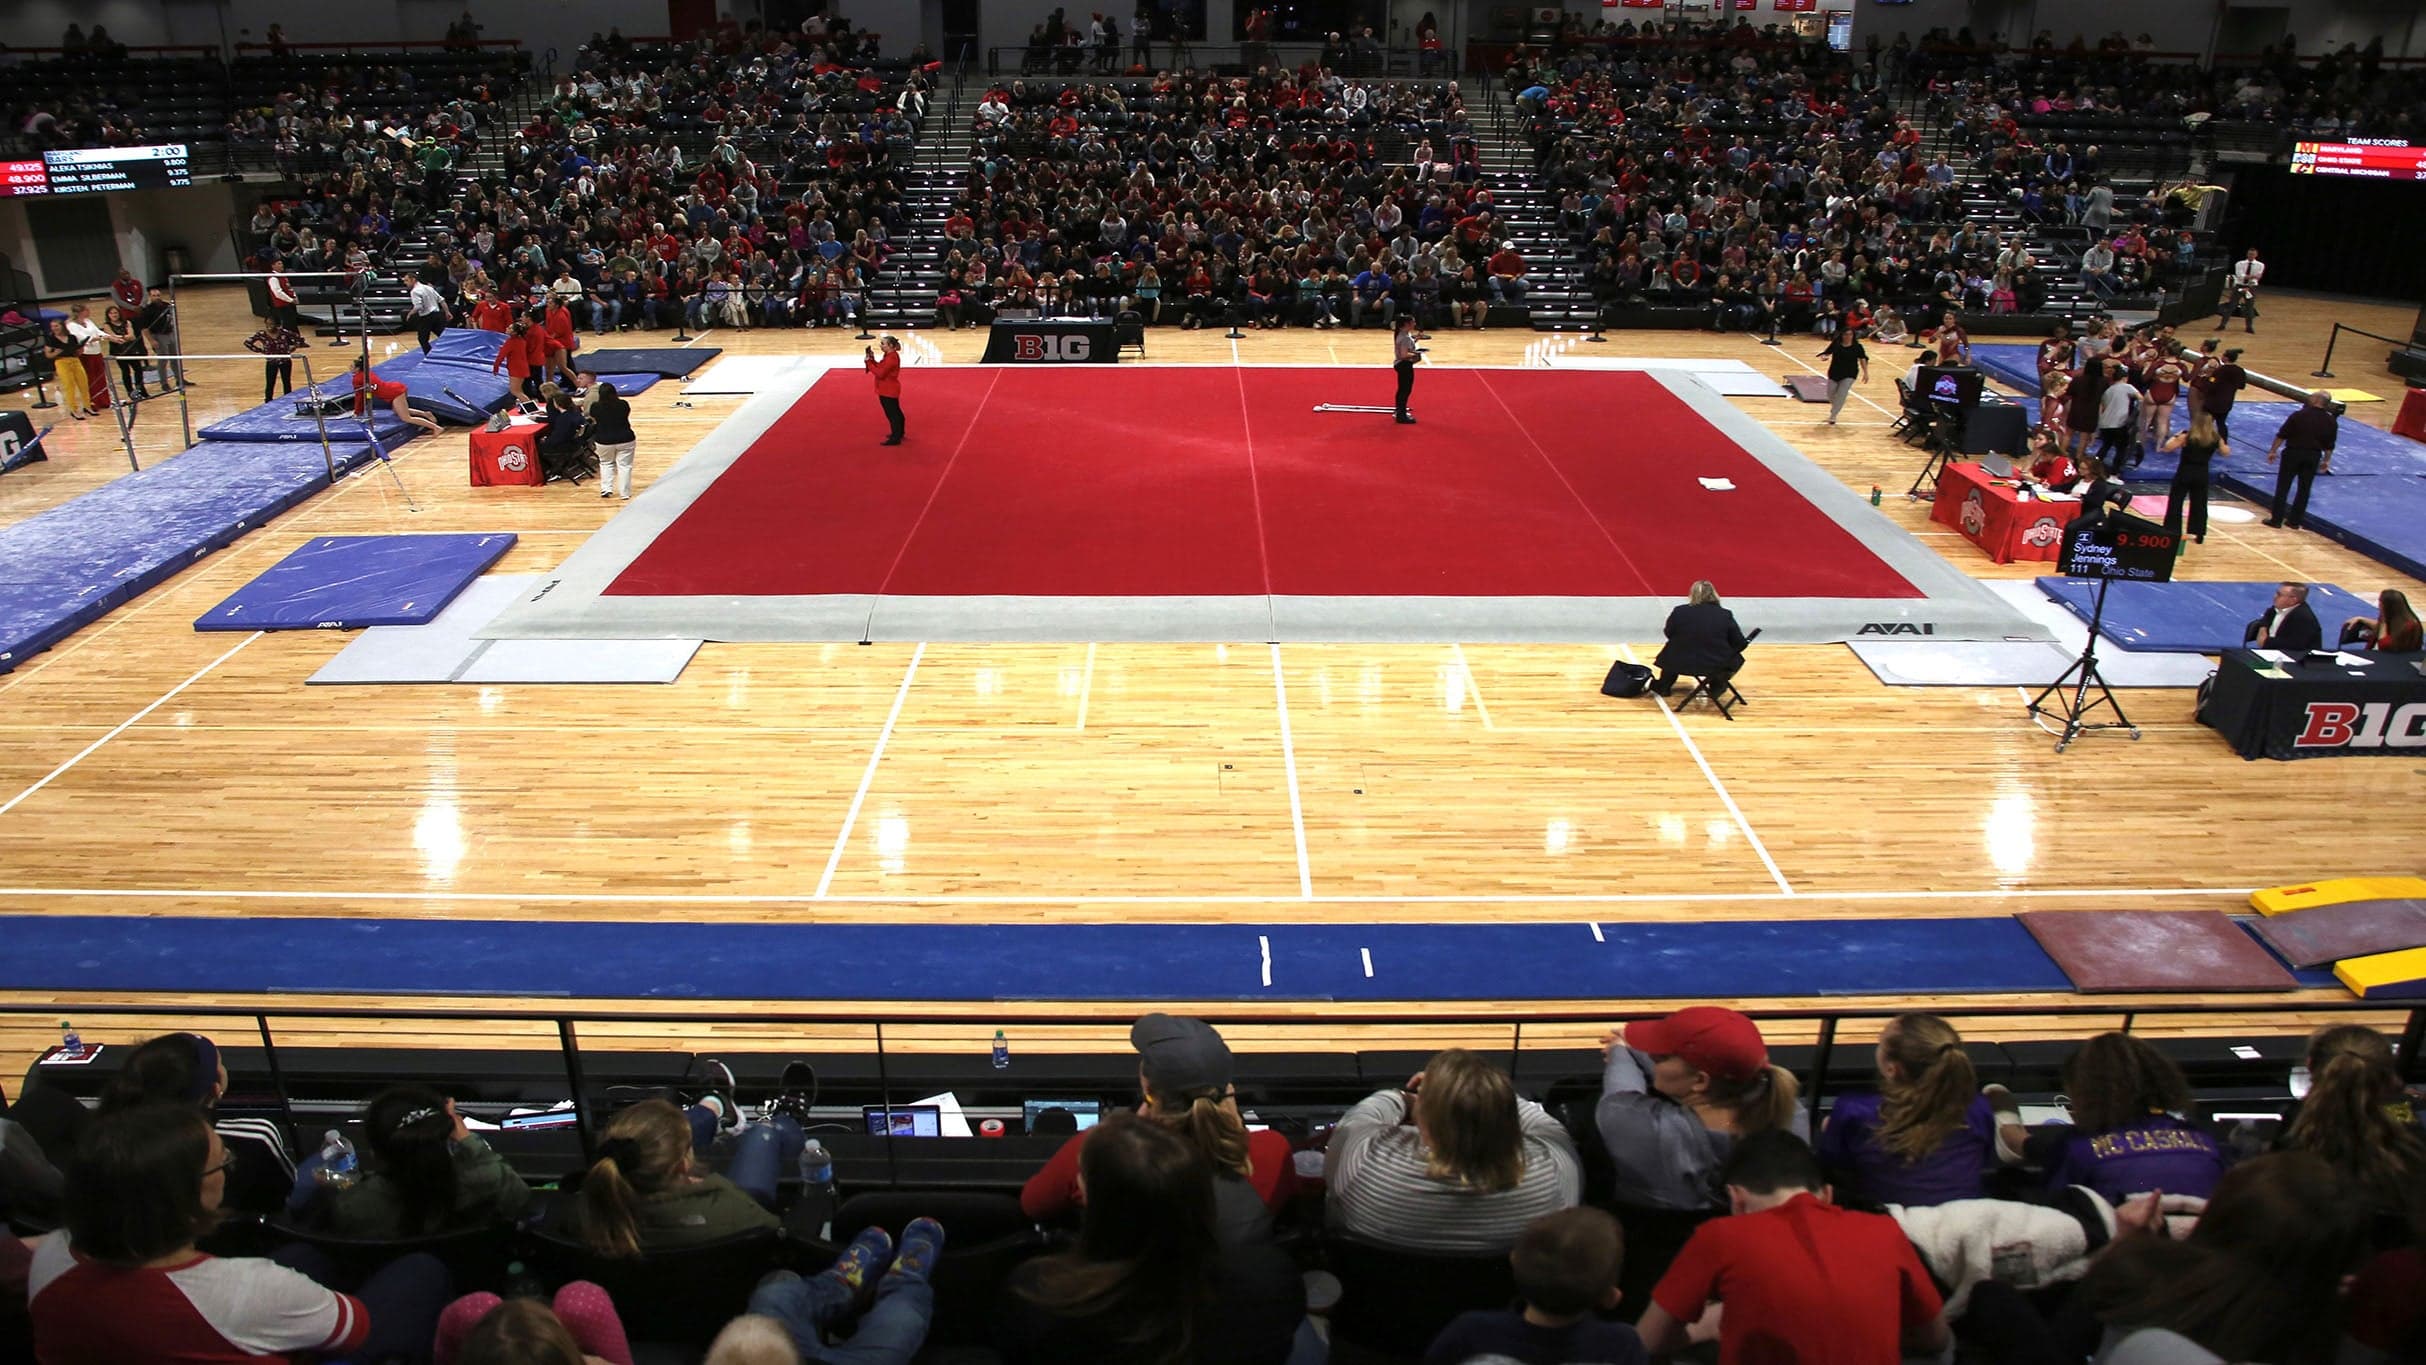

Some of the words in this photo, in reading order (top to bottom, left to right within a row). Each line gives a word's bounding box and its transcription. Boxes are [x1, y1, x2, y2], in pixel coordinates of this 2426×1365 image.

[2347, 137, 2371, 145] TEAM
[2372, 139, 2409, 147] SCORES
[152, 147, 180, 156] 2:00
[2320, 146, 2363, 154] MARYLAND
[9, 163, 42, 172] 49.125
[2315, 166, 2349, 174] CENTRAL
[2350, 168, 2390, 177] MICHIGAN
[8, 175, 46, 183] 48.900
[51, 175, 79, 183] EMMA
[80, 172, 127, 181] SILBERMAN
[12, 185, 48, 194] 37.925
[53, 185, 89, 193] KIRSTEN
[91, 182, 136, 191] PETERMAN
[2040, 524, 2064, 545] STATE
[2117, 534, 2170, 548] 9.900
[2074, 543, 2112, 556] Sydney
[2071, 555, 2117, 566] Jennings
[2070, 564, 2088, 573] 111
[2101, 566, 2125, 576] Ohio
[2128, 567, 2155, 577] State
